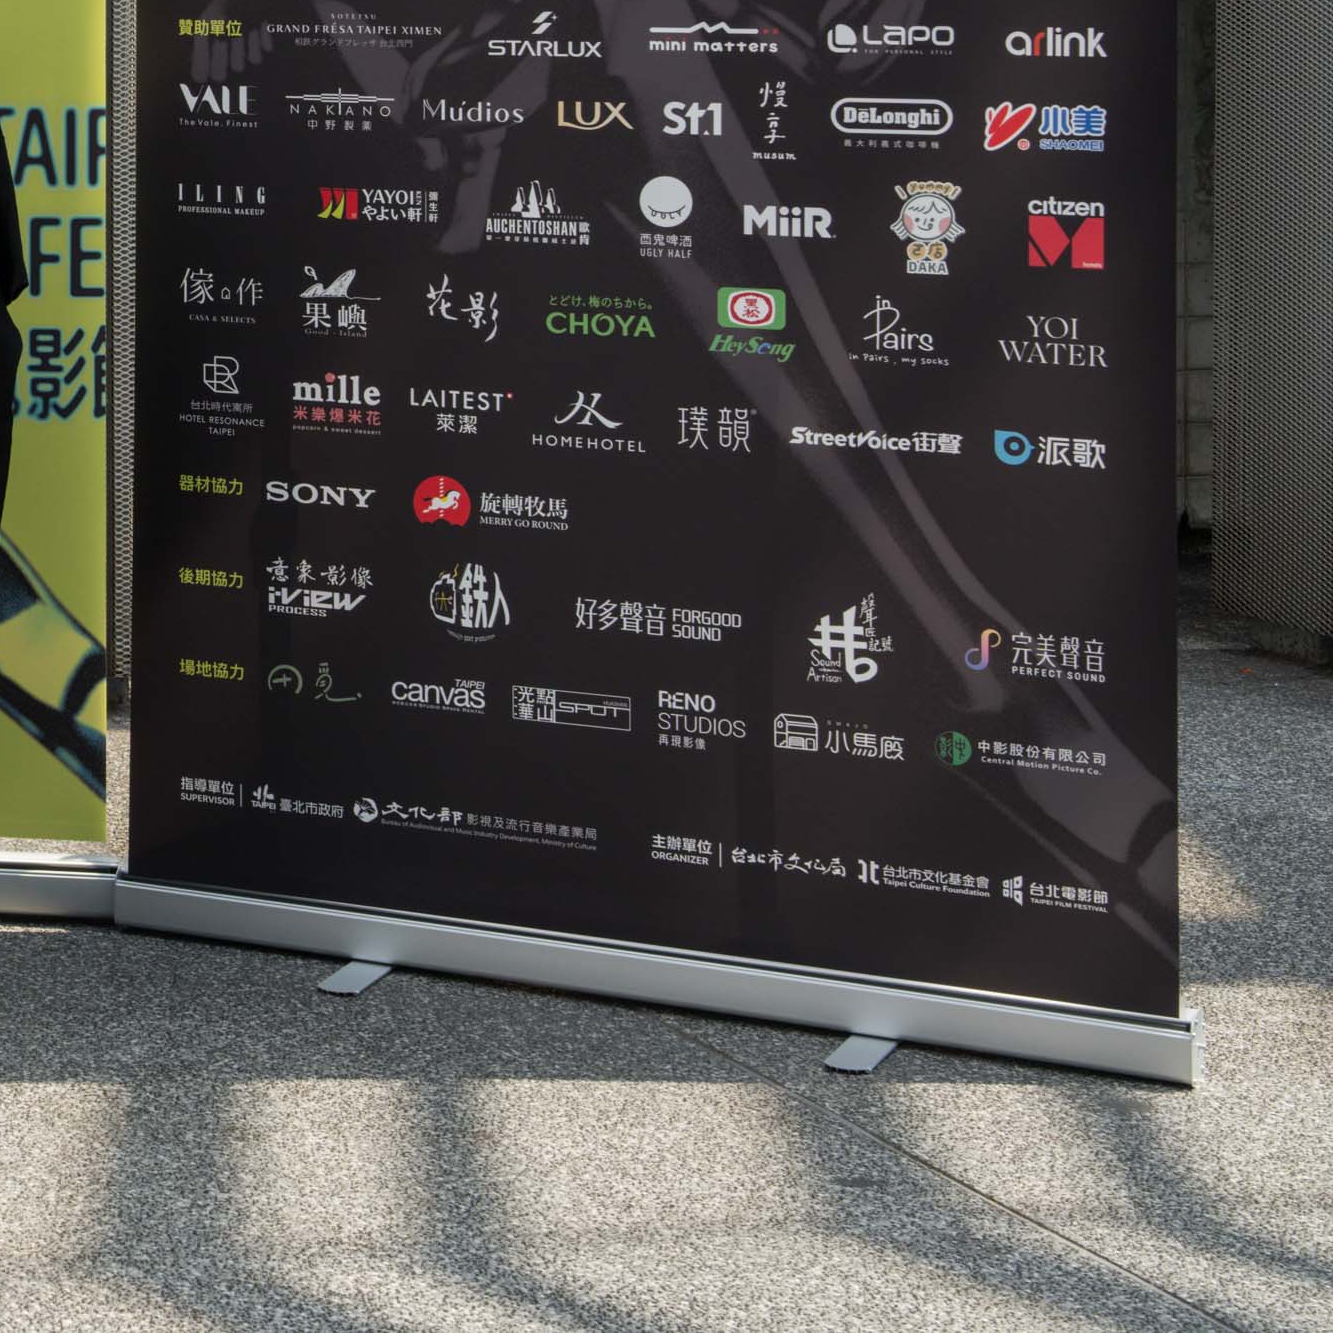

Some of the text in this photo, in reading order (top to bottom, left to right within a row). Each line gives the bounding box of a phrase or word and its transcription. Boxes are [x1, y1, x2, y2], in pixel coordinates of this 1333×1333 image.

[178, 19, 243, 38] 贊助單位
[265, 23, 443, 37] GRAND TAIPEI XIMEN
[487, 39, 603, 59] STARLUX
[649, 38, 779, 54] mini matters
[1005, 27, 1108, 58] arlink
[556, 100, 635, 131] LUX
[1039, 104, 1107, 137] 小美
[1039, 138, 1105, 152] SHAOMEI
[361, 189, 414, 206] YAYOI
[1028, 196, 1106, 217] citizen
[361, 206, 423, 223] やよい軒
[743, 204, 834, 239] MiiR
[485, 217, 578, 238] AUCHENTOSHAN
[639, 248, 694, 260] UGLY HALF
[545, 312, 657, 339] CHOYA
[1026, 315, 1080, 341] YOI
[708, 334, 797, 362] HeySong
[997, 339, 1109, 368] WATER
[292, 372, 382, 407] mille
[409, 387, 505, 413] LAITEST
[179, 414, 266, 428] HOTEL RESONANCE
[208, 426, 236, 437] TAIPEI
[532, 433, 647, 454] HOMEHOTEL
[788, 426, 912, 452] StreetVoice
[1036, 435, 1108, 470] 派歌
[178, 474, 244, 496] 器材協力
[265, 480, 376, 508] SONY
[479, 516, 570, 531] MERRY ROUND
[178, 567, 245, 590] 後期協力
[268, 604, 328, 618] PROCESS
[574, 596, 666, 638] 好多聲音
[671, 607, 743, 629] FORGOOD
[671, 624, 723, 642] SOUND
[1010, 632, 1106, 673] 完美聲音
[178, 658, 245, 682] 場地協力
[1011, 665, 1106, 684] PERFECT SOUND
[391, 680, 486, 710] canvas
[453, 678, 486, 691] TAIPEI
[658, 690, 717, 714] RENO
[657, 712, 747, 739] STUDIOS
[977, 739, 1107, 767] 中影股份有限公司
[180, 776, 236, 796] 指導單位
[180, 792, 236, 807] SUPERVISOR
[651, 833, 713, 856] 主辦單位
[650, 850, 710, 866] ORGANIZER
[883, 863, 990, 890] 台北市文化基金會
[883, 877, 991, 898] Taipei Culture Foundation
[1029, 880, 1110, 905] 台北電影節
